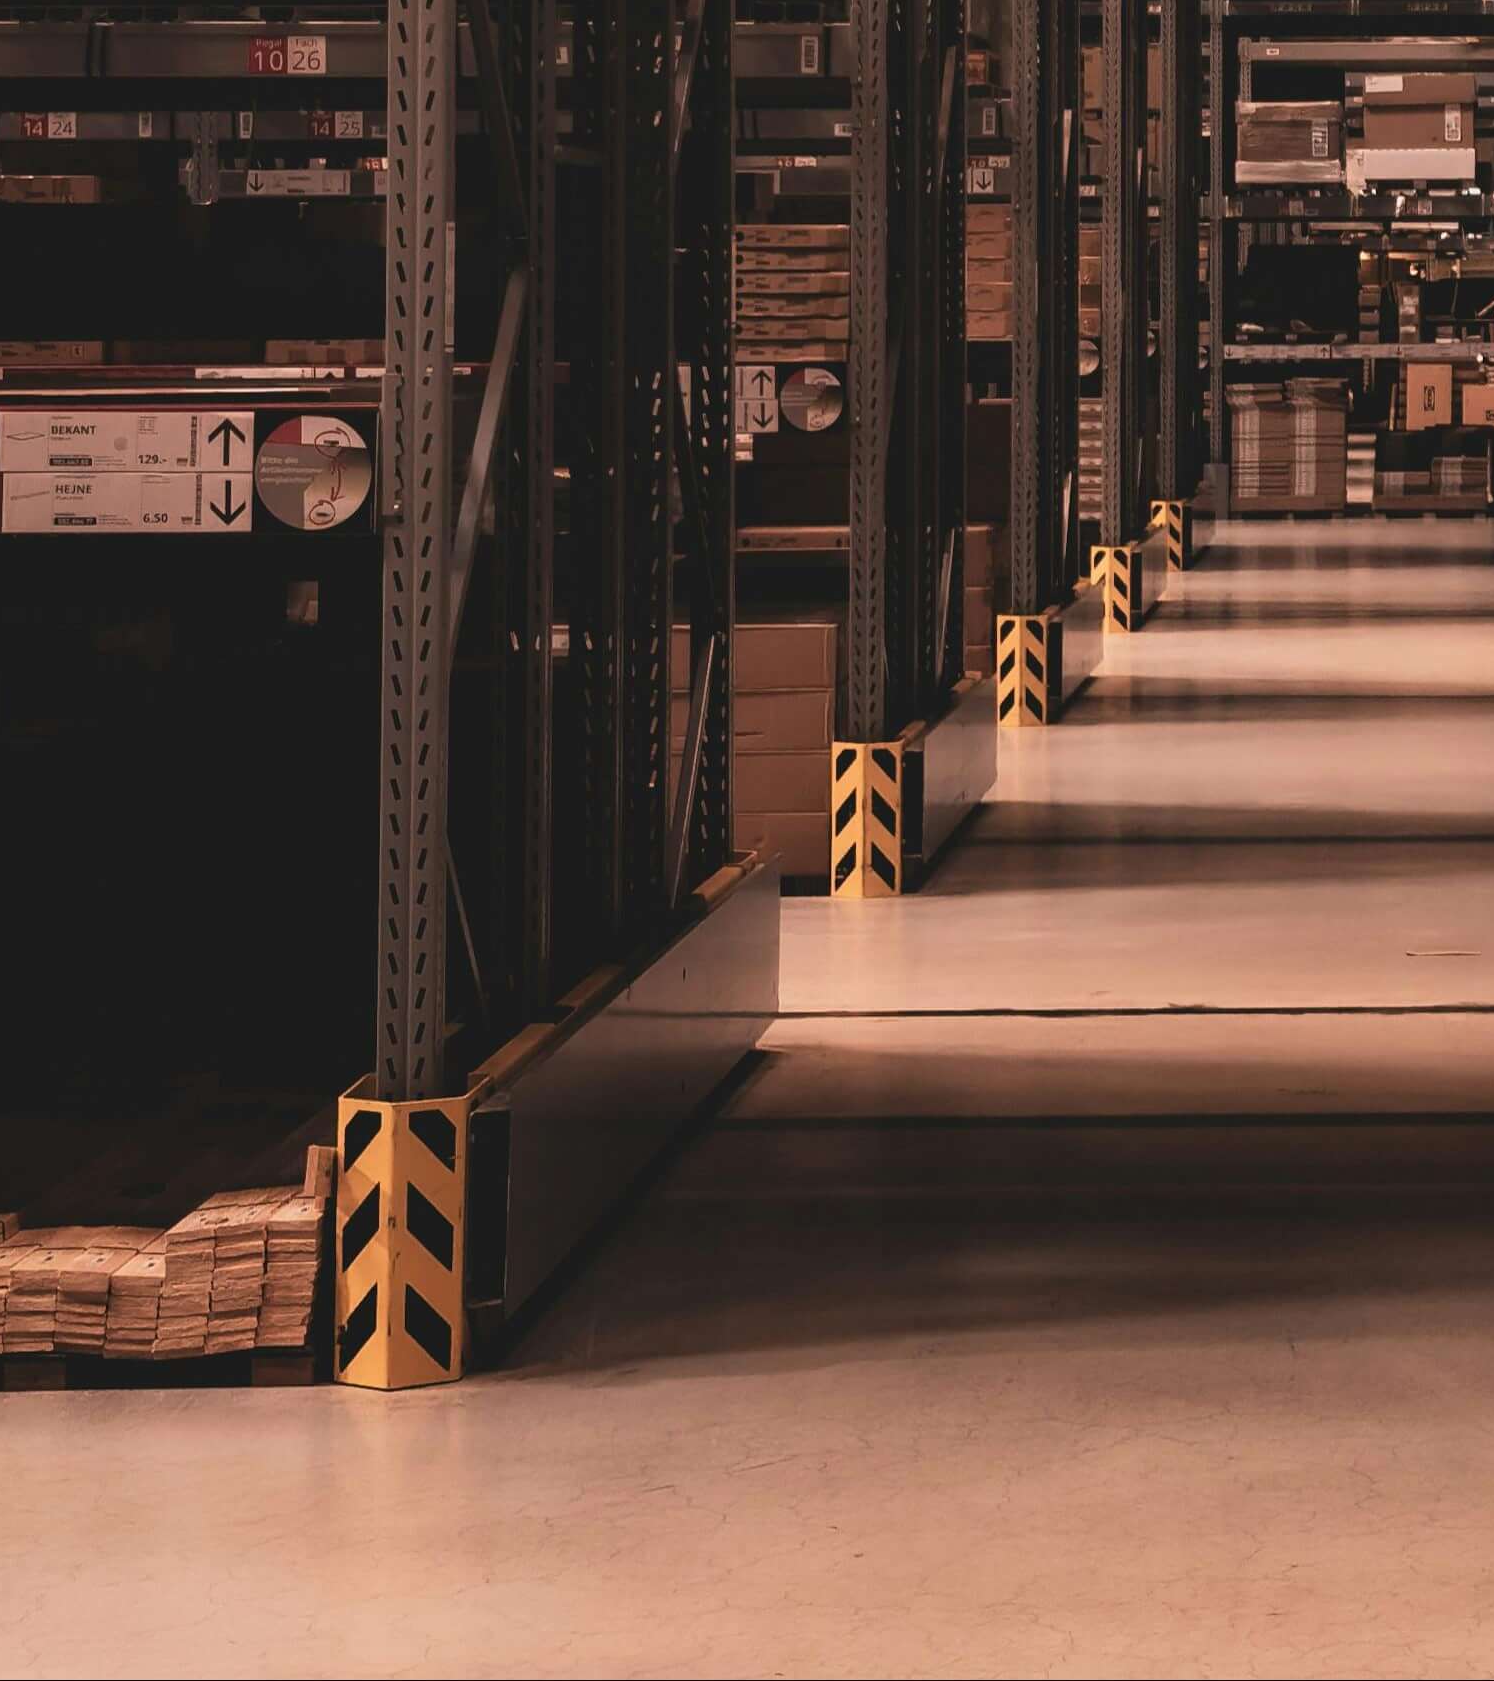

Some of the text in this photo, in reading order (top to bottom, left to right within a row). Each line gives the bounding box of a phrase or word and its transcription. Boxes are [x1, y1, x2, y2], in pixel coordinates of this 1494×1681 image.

[256, 38, 282, 49] Regal
[296, 38, 317, 47] Fach
[255, 50, 283, 71] 10
[292, 50, 321, 71] 26
[26, 121, 43, 136] 14
[52, 121, 72, 137] 24
[313, 121, 329, 136] 14
[340, 121, 360, 136] 25
[51, 425, 98, 435] BEKANT
[138, 455, 168, 465] 129.-
[55, 484, 93, 495] HEJNE
[143, 513, 169, 524] 6.50
